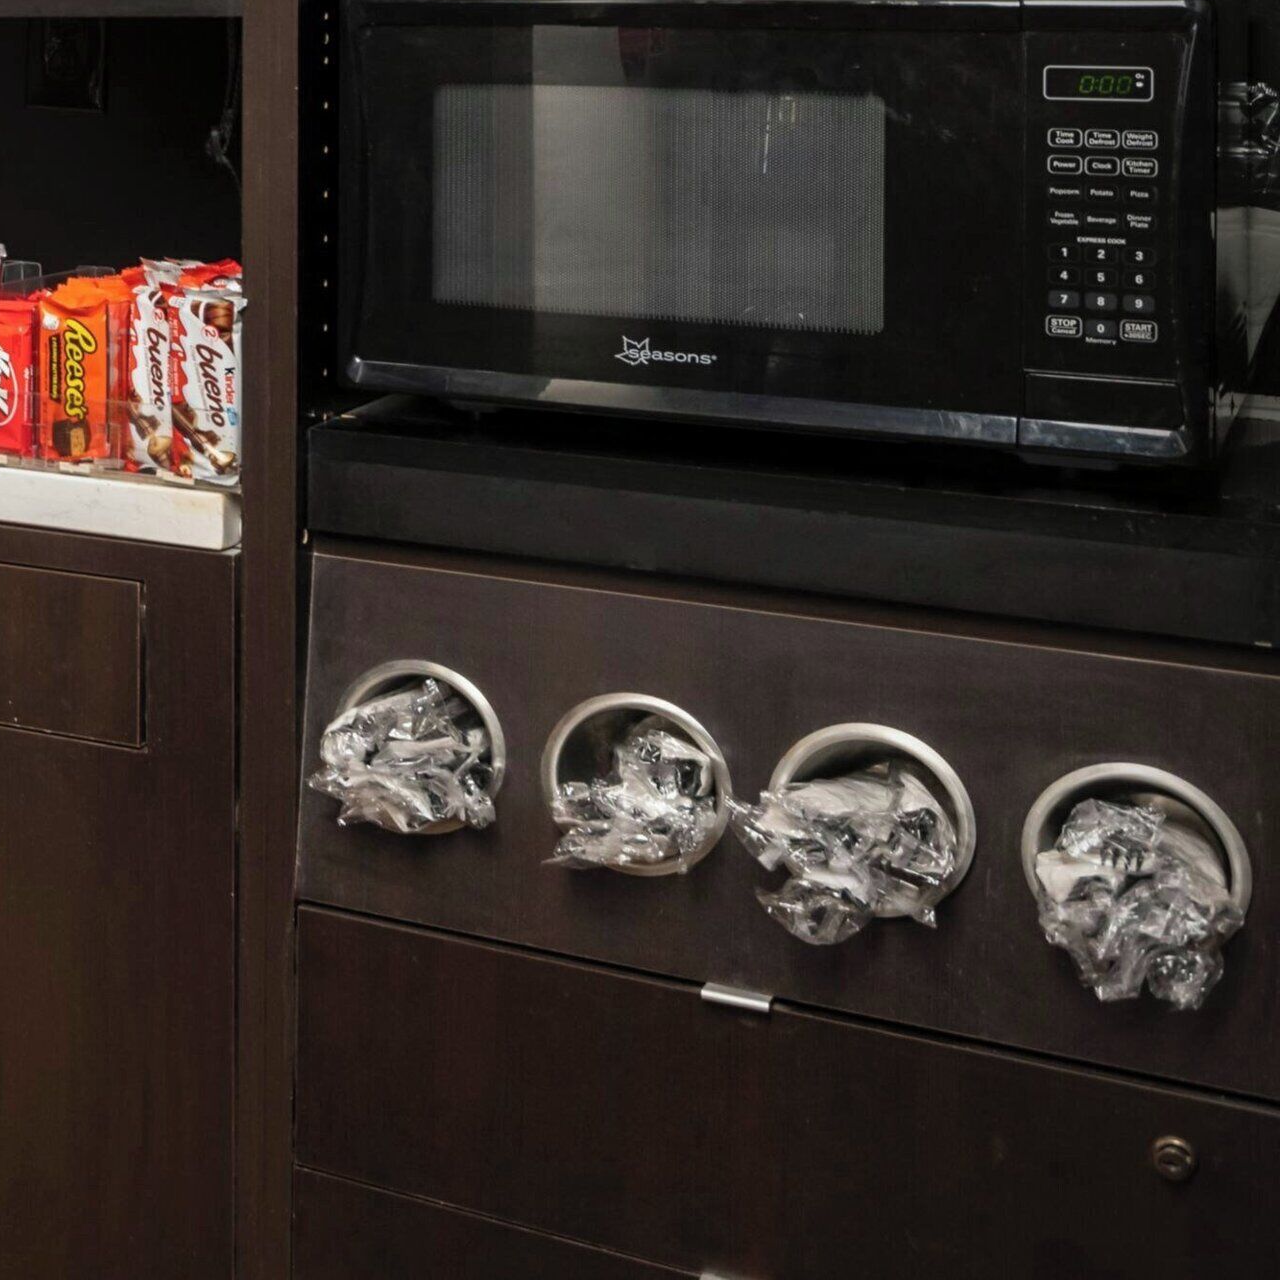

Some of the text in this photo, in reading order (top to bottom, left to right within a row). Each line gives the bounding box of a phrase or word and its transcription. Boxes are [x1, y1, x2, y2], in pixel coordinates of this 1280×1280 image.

[1079, 75, 1133, 94] 0:00
[1050, 187, 1080, 195] Popcorn
[1090, 189, 1114, 197] Potato
[1087, 216, 1116, 224] Beverage
[1061, 247, 1068, 257] 1
[1097, 249, 1105, 259] 2
[1135, 251, 1143, 261] 3
[1060, 271, 1068, 280] 4
[1097, 272, 1105, 282] 5
[1135, 275, 1143, 284] 6
[1060, 294, 1068, 304] 7
[1097, 296, 1105, 306] 8
[1135, 299, 1143, 308] 9
[1051, 318, 1077, 326] STOP
[1097, 324, 1104, 333] 0
[1125, 323, 1152, 332] START
[1086, 337, 1117, 345] Memory
[628, 348, 712, 364] seasons
[64, 319, 97, 420] Reese's
[196, 344, 225, 427] bueno
